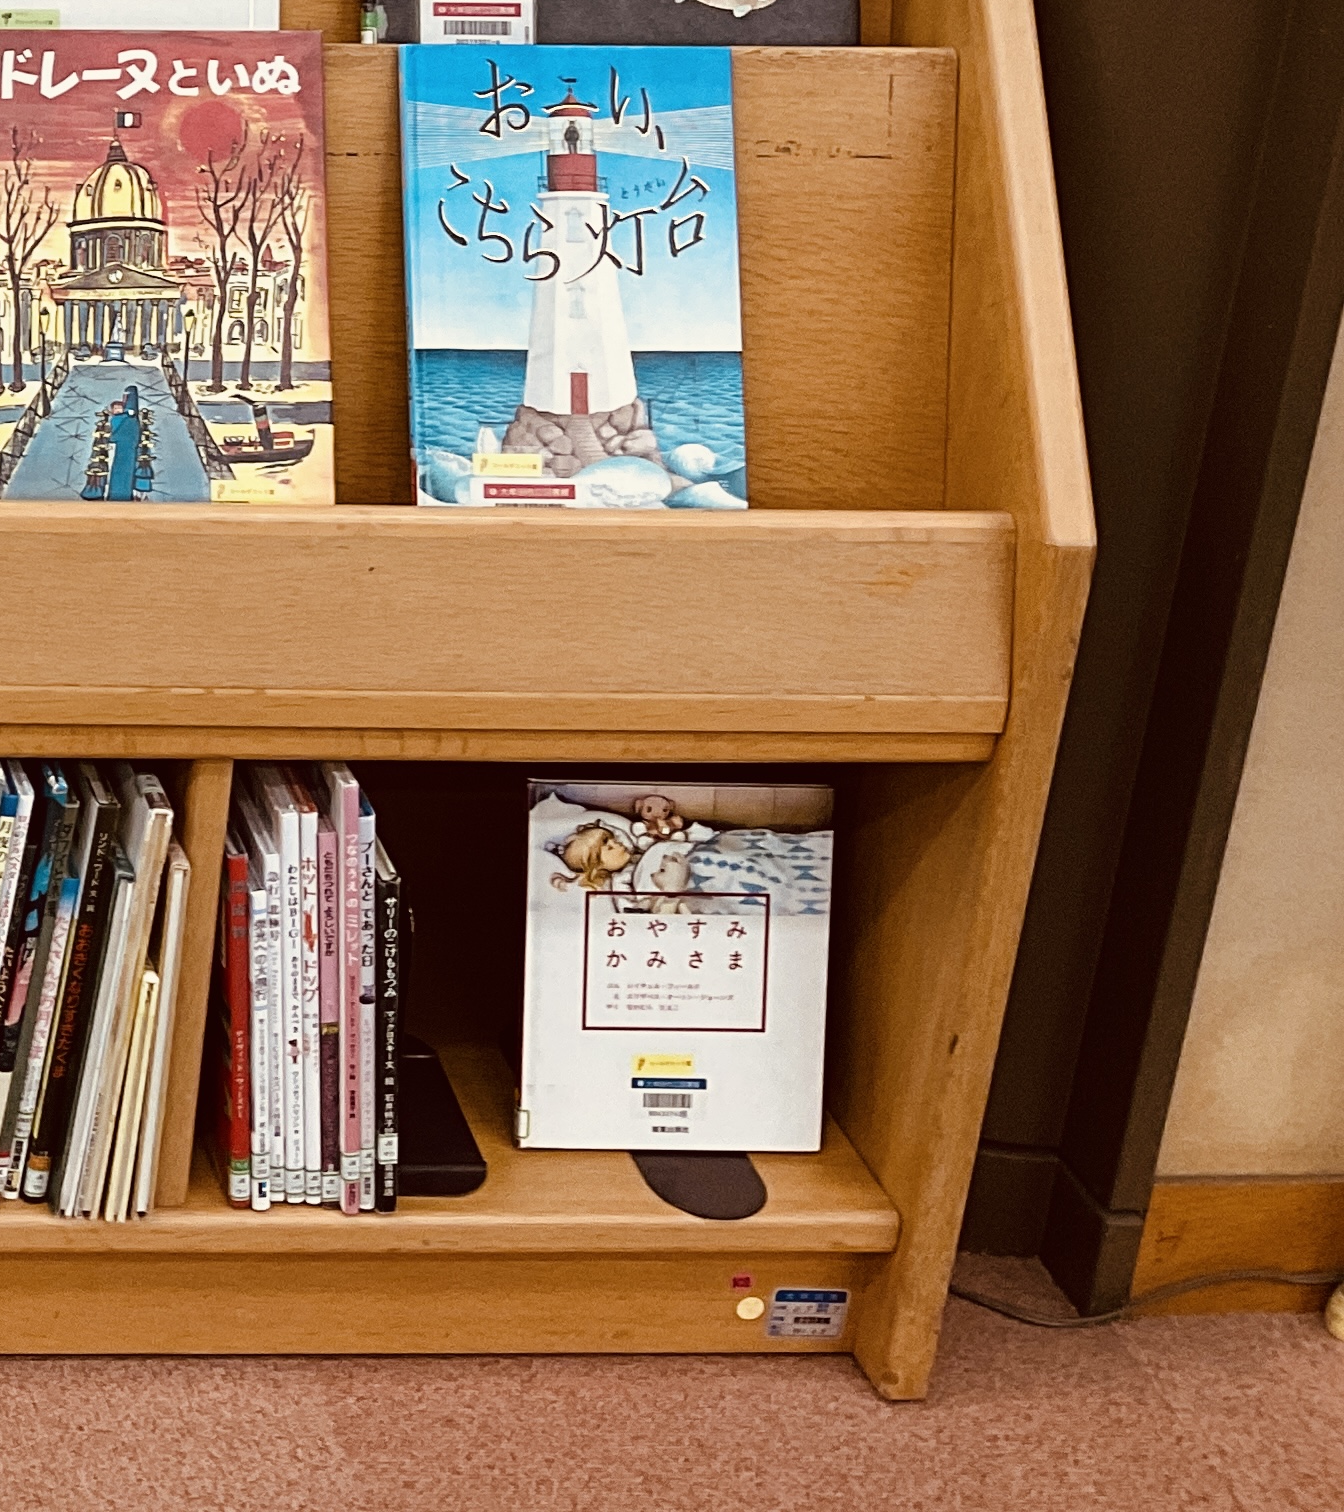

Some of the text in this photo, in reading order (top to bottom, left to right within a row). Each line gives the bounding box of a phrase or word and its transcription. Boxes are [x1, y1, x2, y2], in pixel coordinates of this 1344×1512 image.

[301, 857, 318, 1003] ホット ドッグ
[361, 839, 375, 967] プーさんと であった日
[383, 897, 398, 998] サリーのこけももつみ
[606, 918, 748, 939] おやすみ
[605, 949, 744, 970] かみさま
